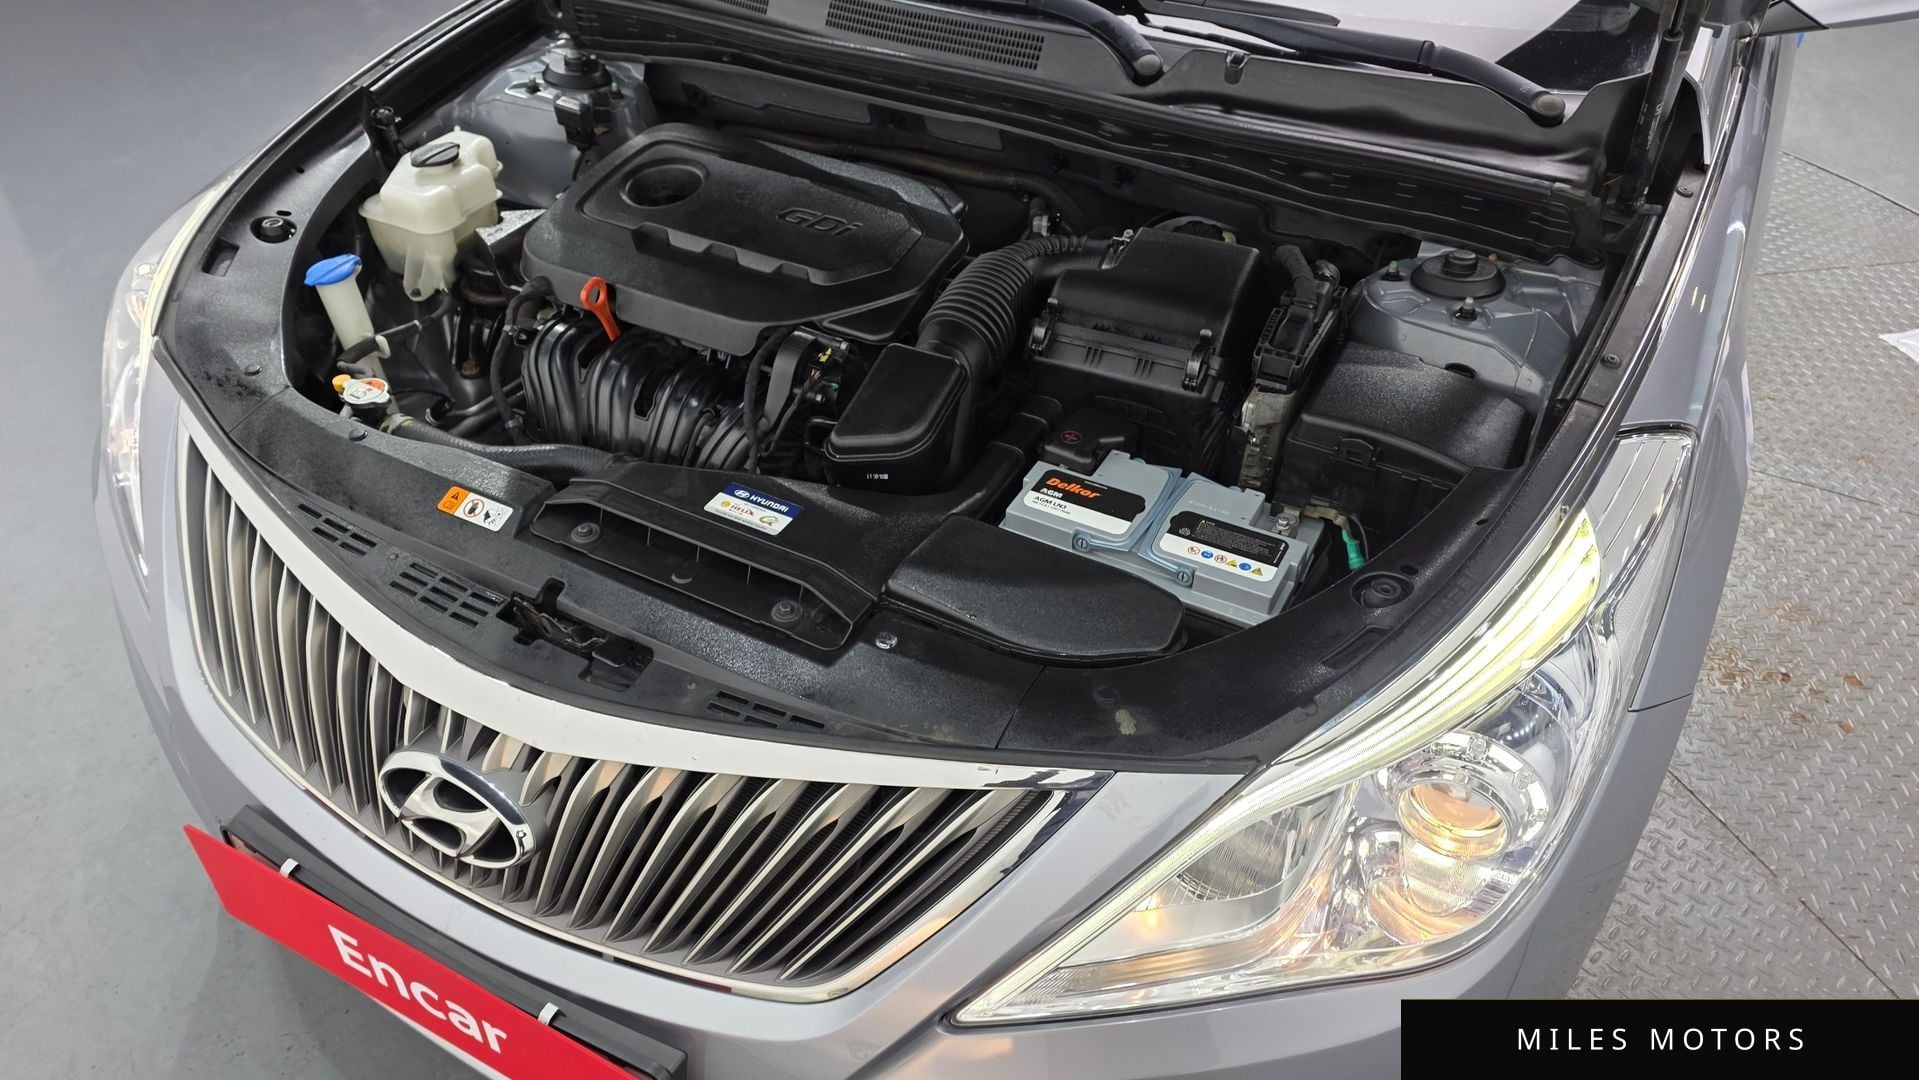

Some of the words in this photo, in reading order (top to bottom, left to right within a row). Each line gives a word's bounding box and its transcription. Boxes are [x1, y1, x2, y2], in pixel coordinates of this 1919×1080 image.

[1040, 487, 1063, 499] AGM
[1046, 477, 1100, 498] Delkor
[749, 494, 790, 513] HYUNDAI
[1033, 496, 1052, 505] AGM
[731, 504, 754, 516] HELIX
[327, 924, 507, 1054] Encar
